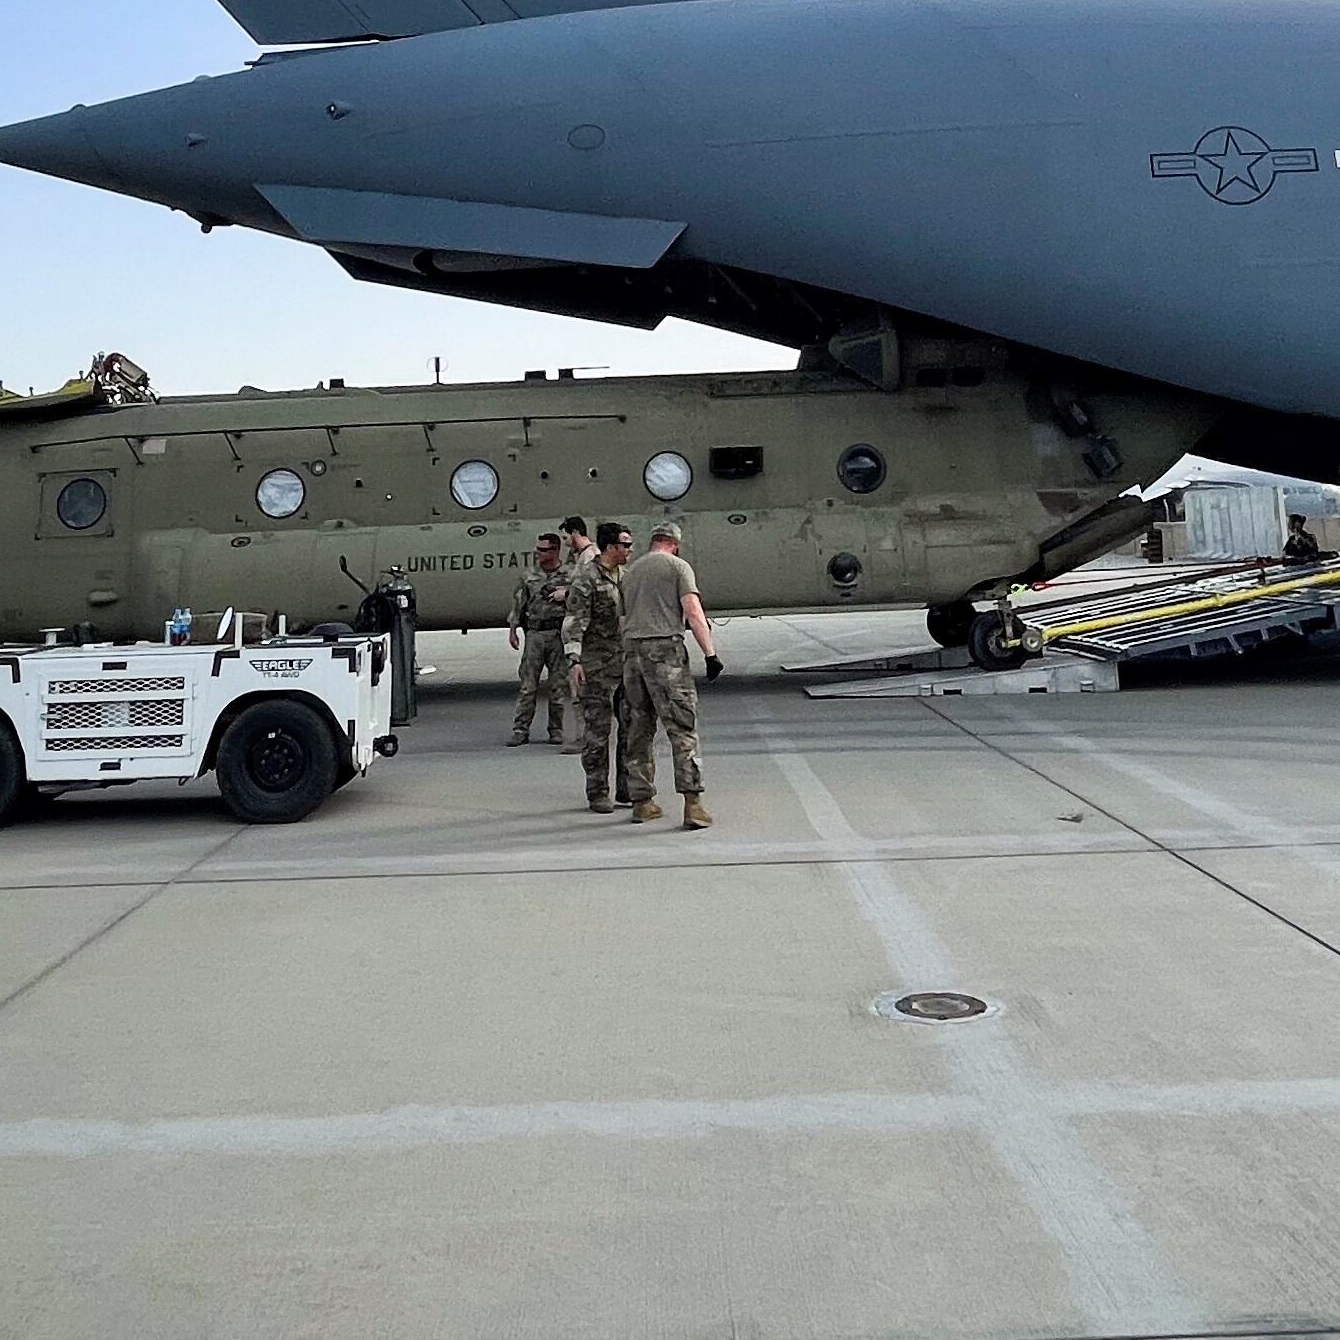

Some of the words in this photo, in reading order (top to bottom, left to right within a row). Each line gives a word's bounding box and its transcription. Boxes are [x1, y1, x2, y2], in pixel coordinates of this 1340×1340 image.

[407, 554, 474, 573] UNITED
[483, 551, 540, 569] STATE
[262, 661, 299, 671] EAGLE
